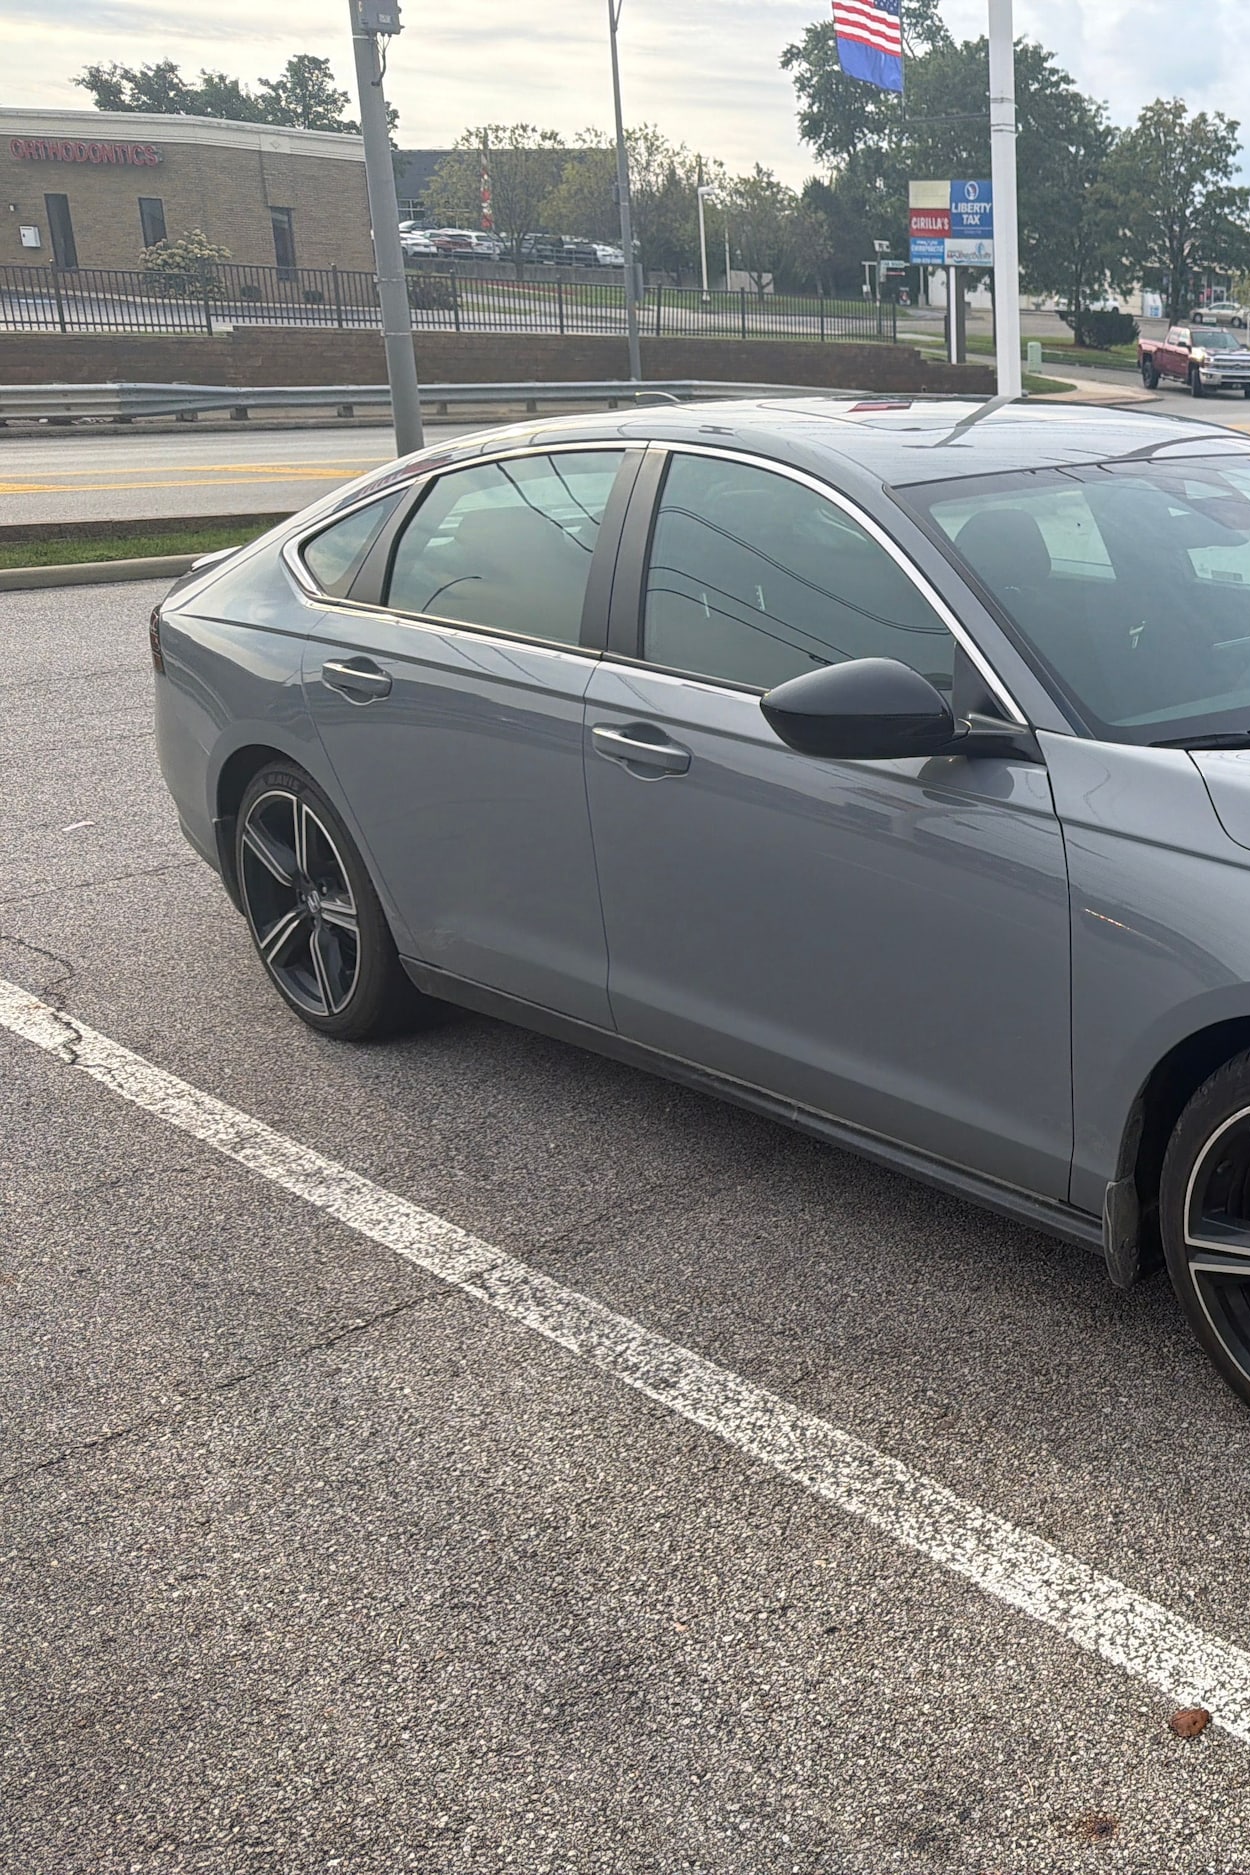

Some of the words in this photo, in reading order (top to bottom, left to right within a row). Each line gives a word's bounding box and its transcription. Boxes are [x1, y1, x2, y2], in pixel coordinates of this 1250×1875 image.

[10, 138, 158, 166] ORTHODONTICS
[952, 202, 992, 213] LIBERTY
[911, 216, 950, 230] CIRILLA'S
[962, 214, 981, 225] TAX
